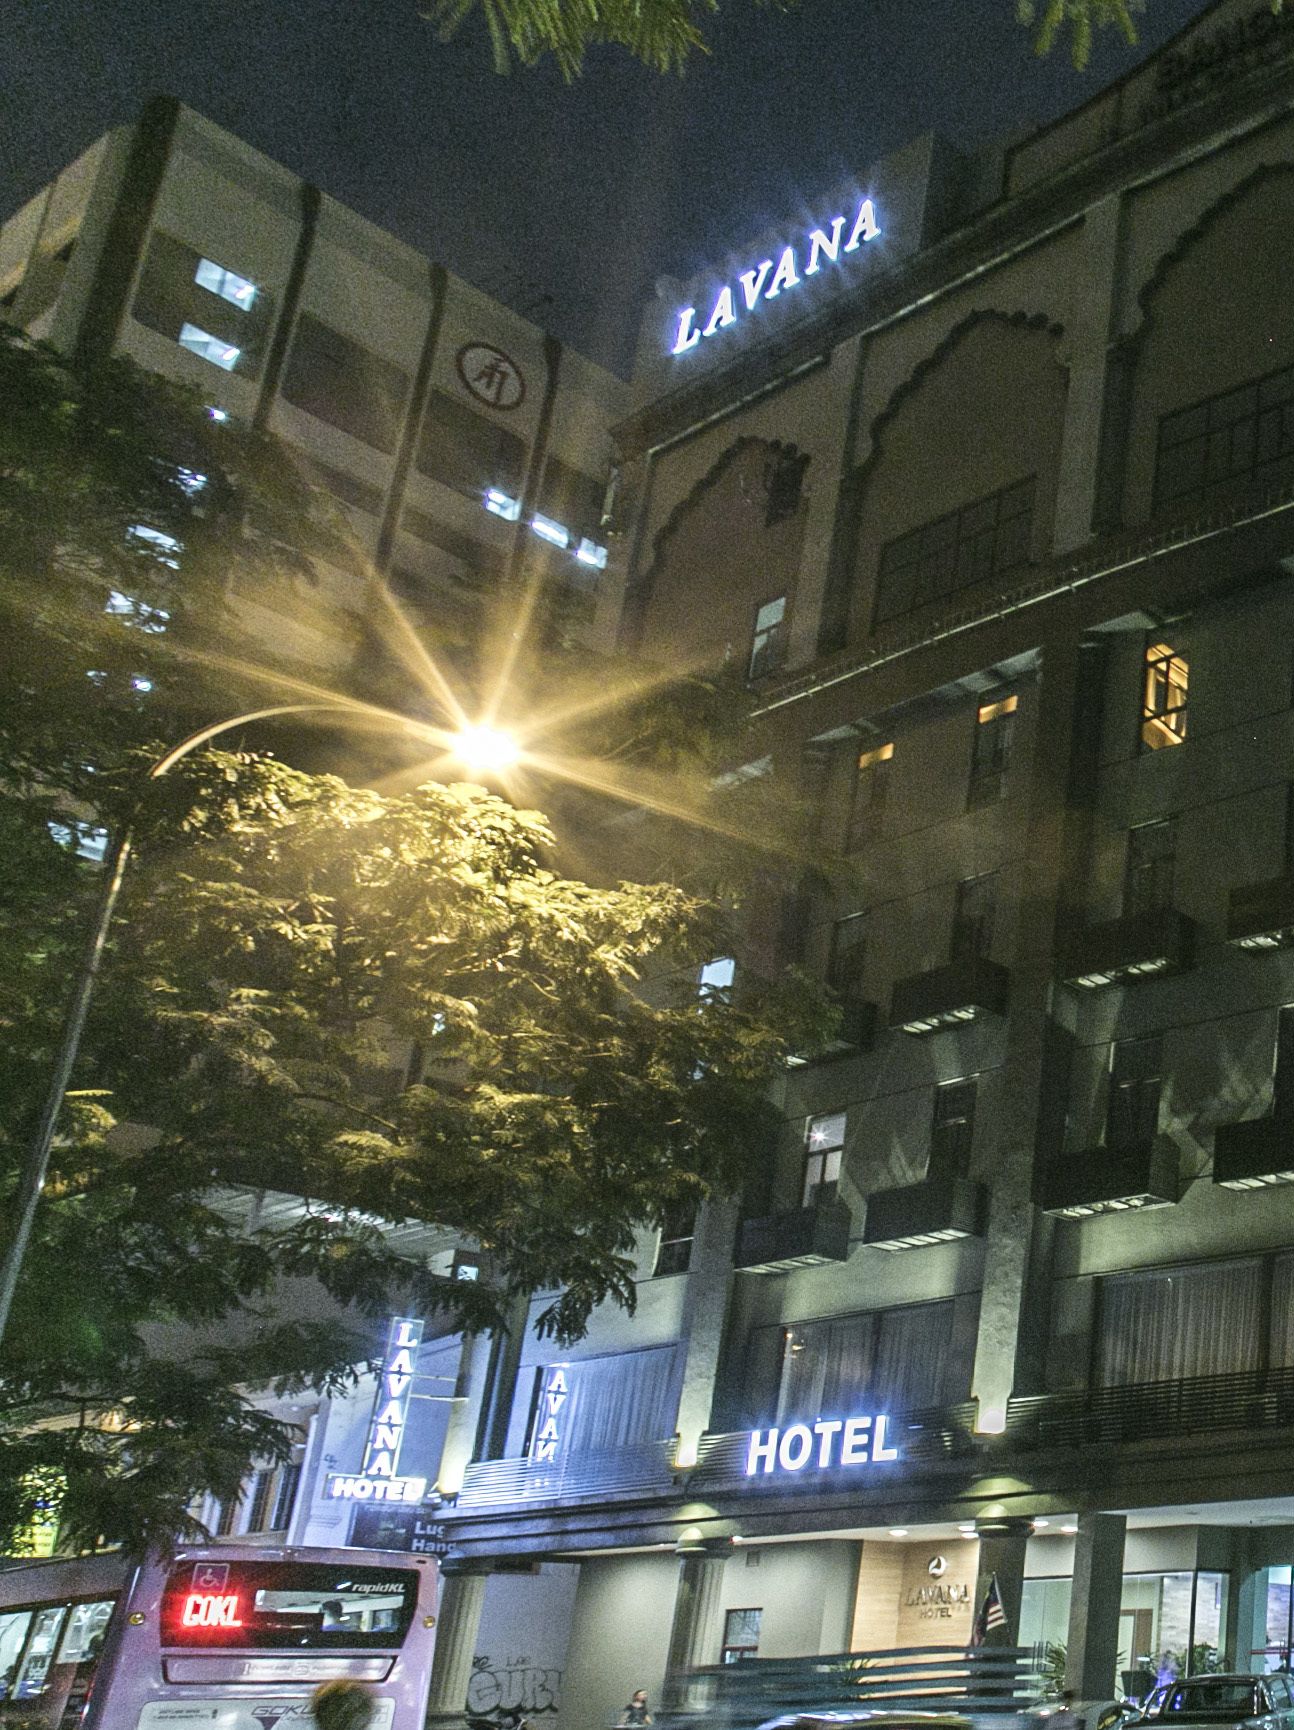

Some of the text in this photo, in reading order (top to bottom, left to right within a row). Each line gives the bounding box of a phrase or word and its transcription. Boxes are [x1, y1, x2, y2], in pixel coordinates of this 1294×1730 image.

[671, 199, 881, 354] LAVANA
[368, 1322, 418, 1476] LAVANA
[746, 1414, 898, 1476] HOTEL
[332, 1478, 423, 1501] HOTEL
[352, 1583, 406, 1594] rapidKL
[905, 1584, 970, 1607] LAVANA
[920, 1606, 952, 1619] HOTEL
